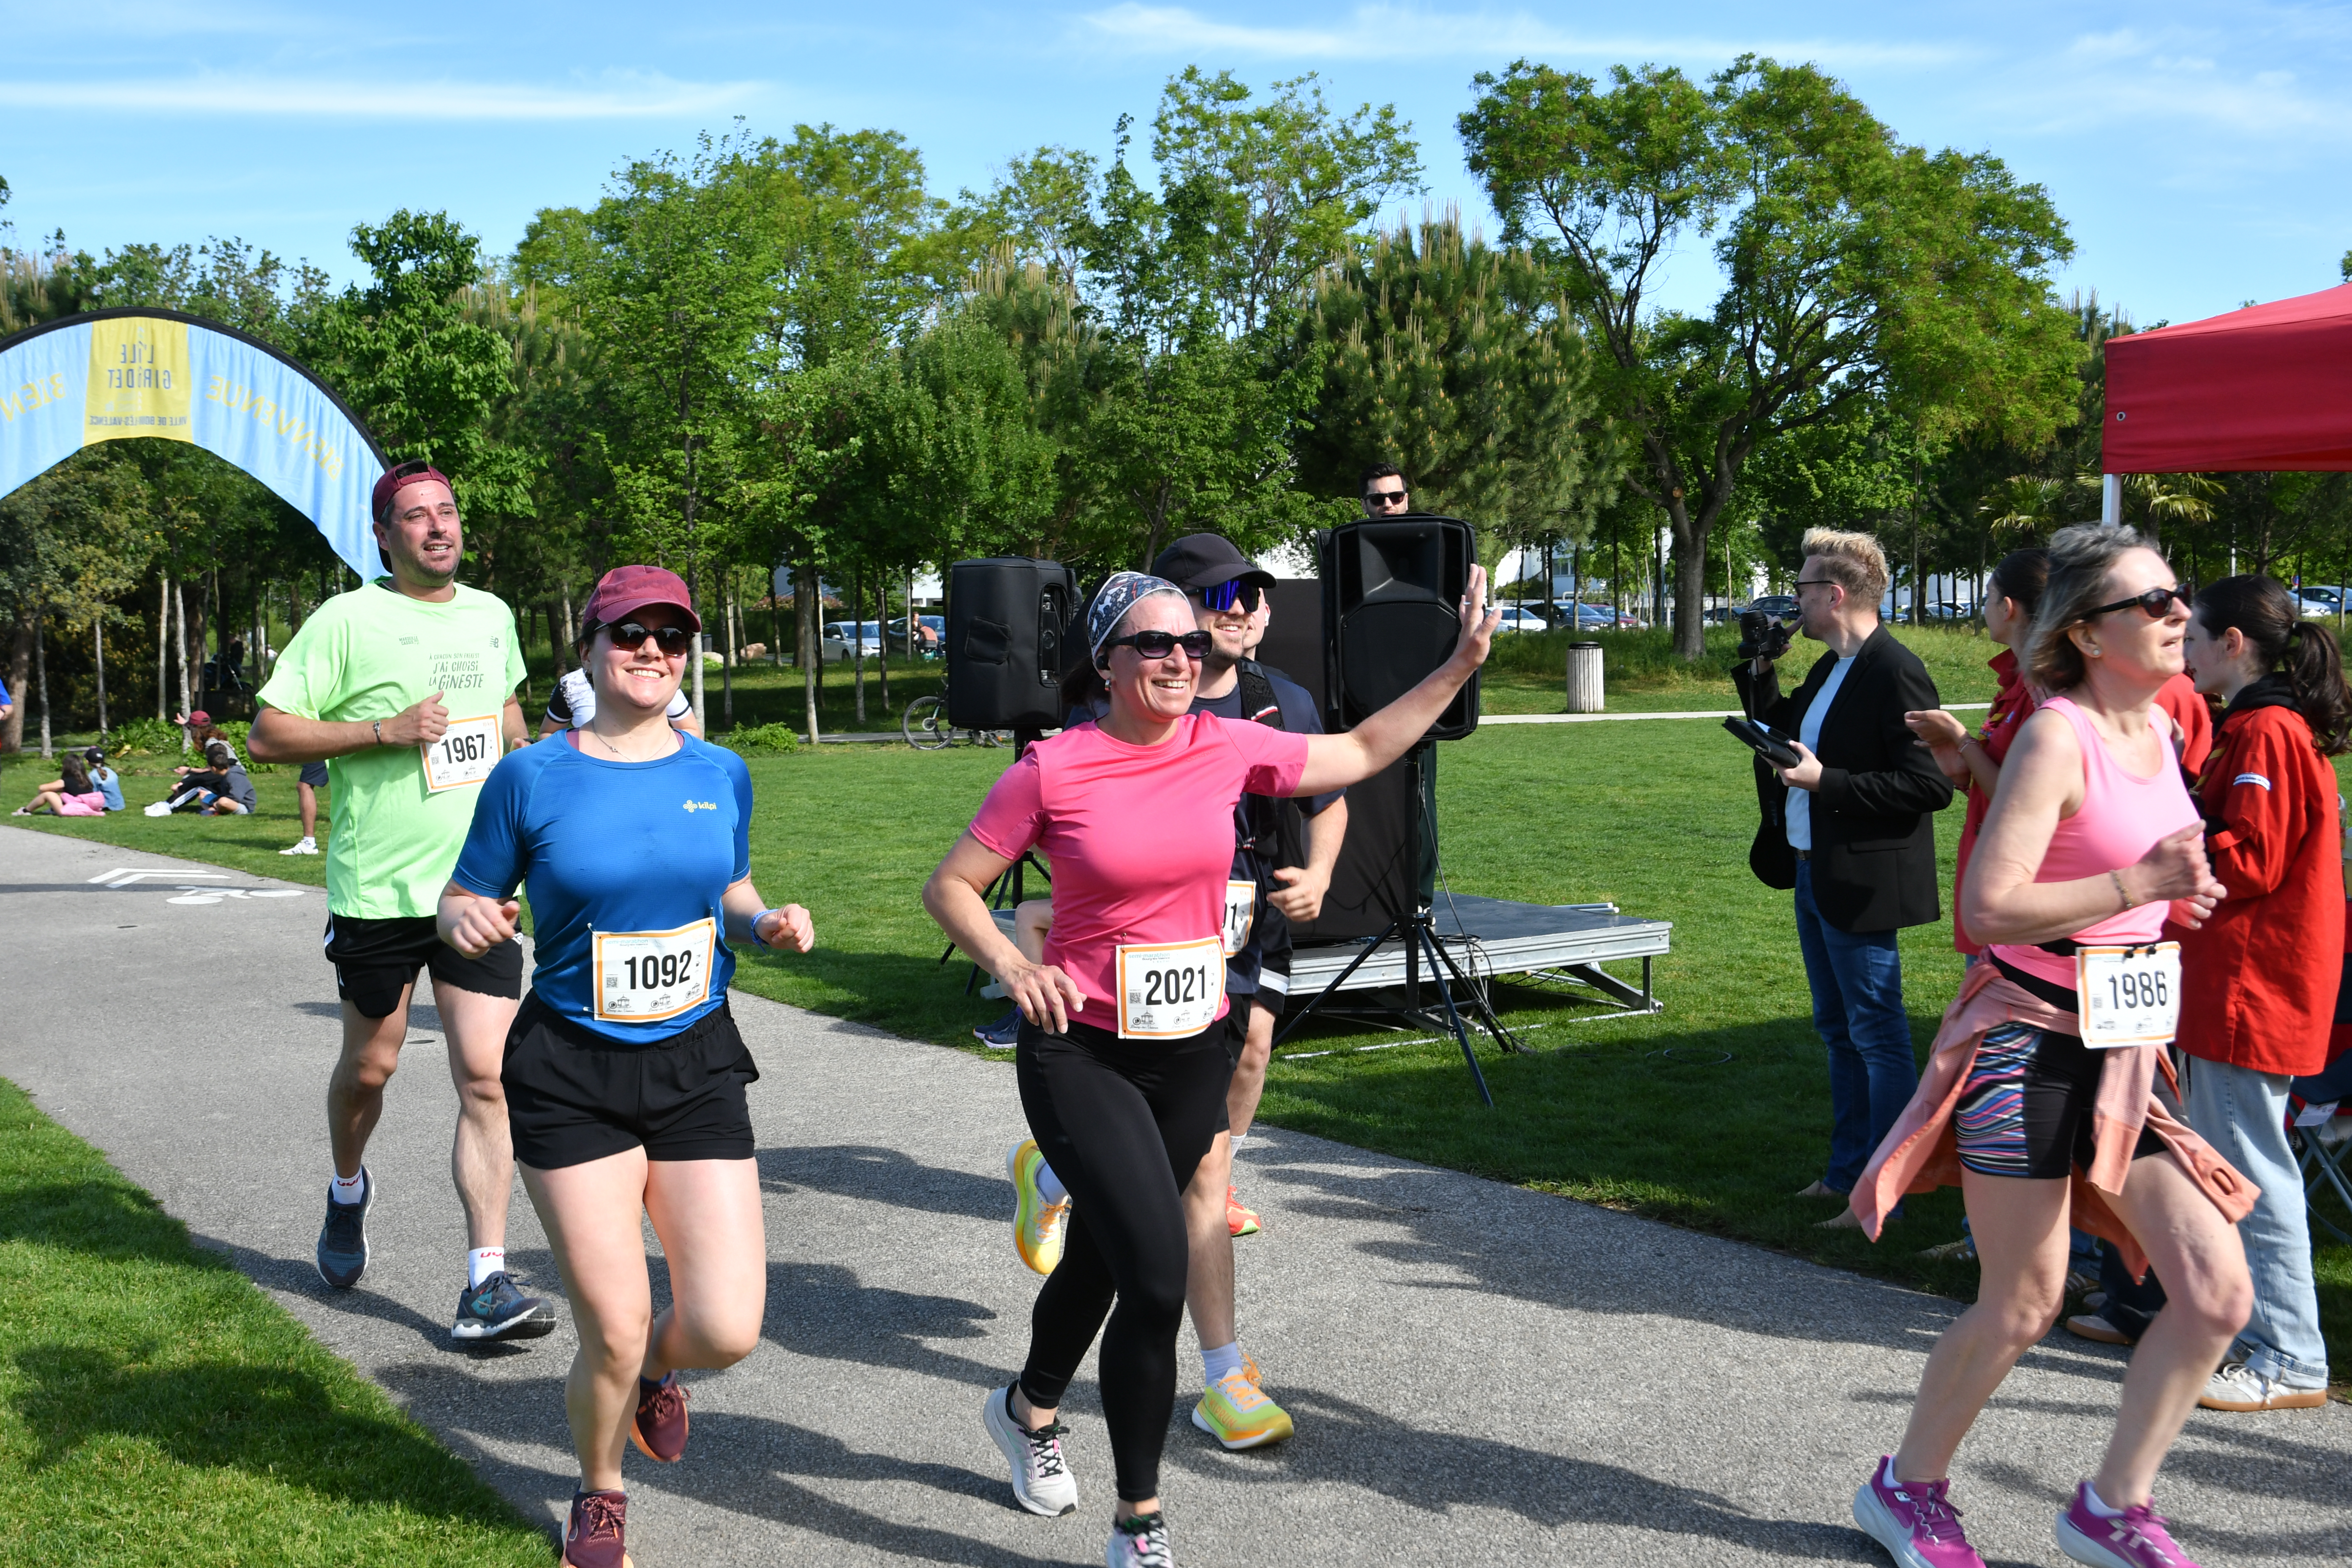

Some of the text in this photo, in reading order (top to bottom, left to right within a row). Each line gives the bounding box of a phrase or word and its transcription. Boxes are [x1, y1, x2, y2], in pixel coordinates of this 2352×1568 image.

[429, 676, 437, 686] LA
[441, 733, 486, 764] 1967
[698, 801, 717, 810] kilpi
[624, 949, 692, 990] 1092
[1145, 965, 1205, 1005] 2021
[2108, 970, 2167, 1010] 1986
